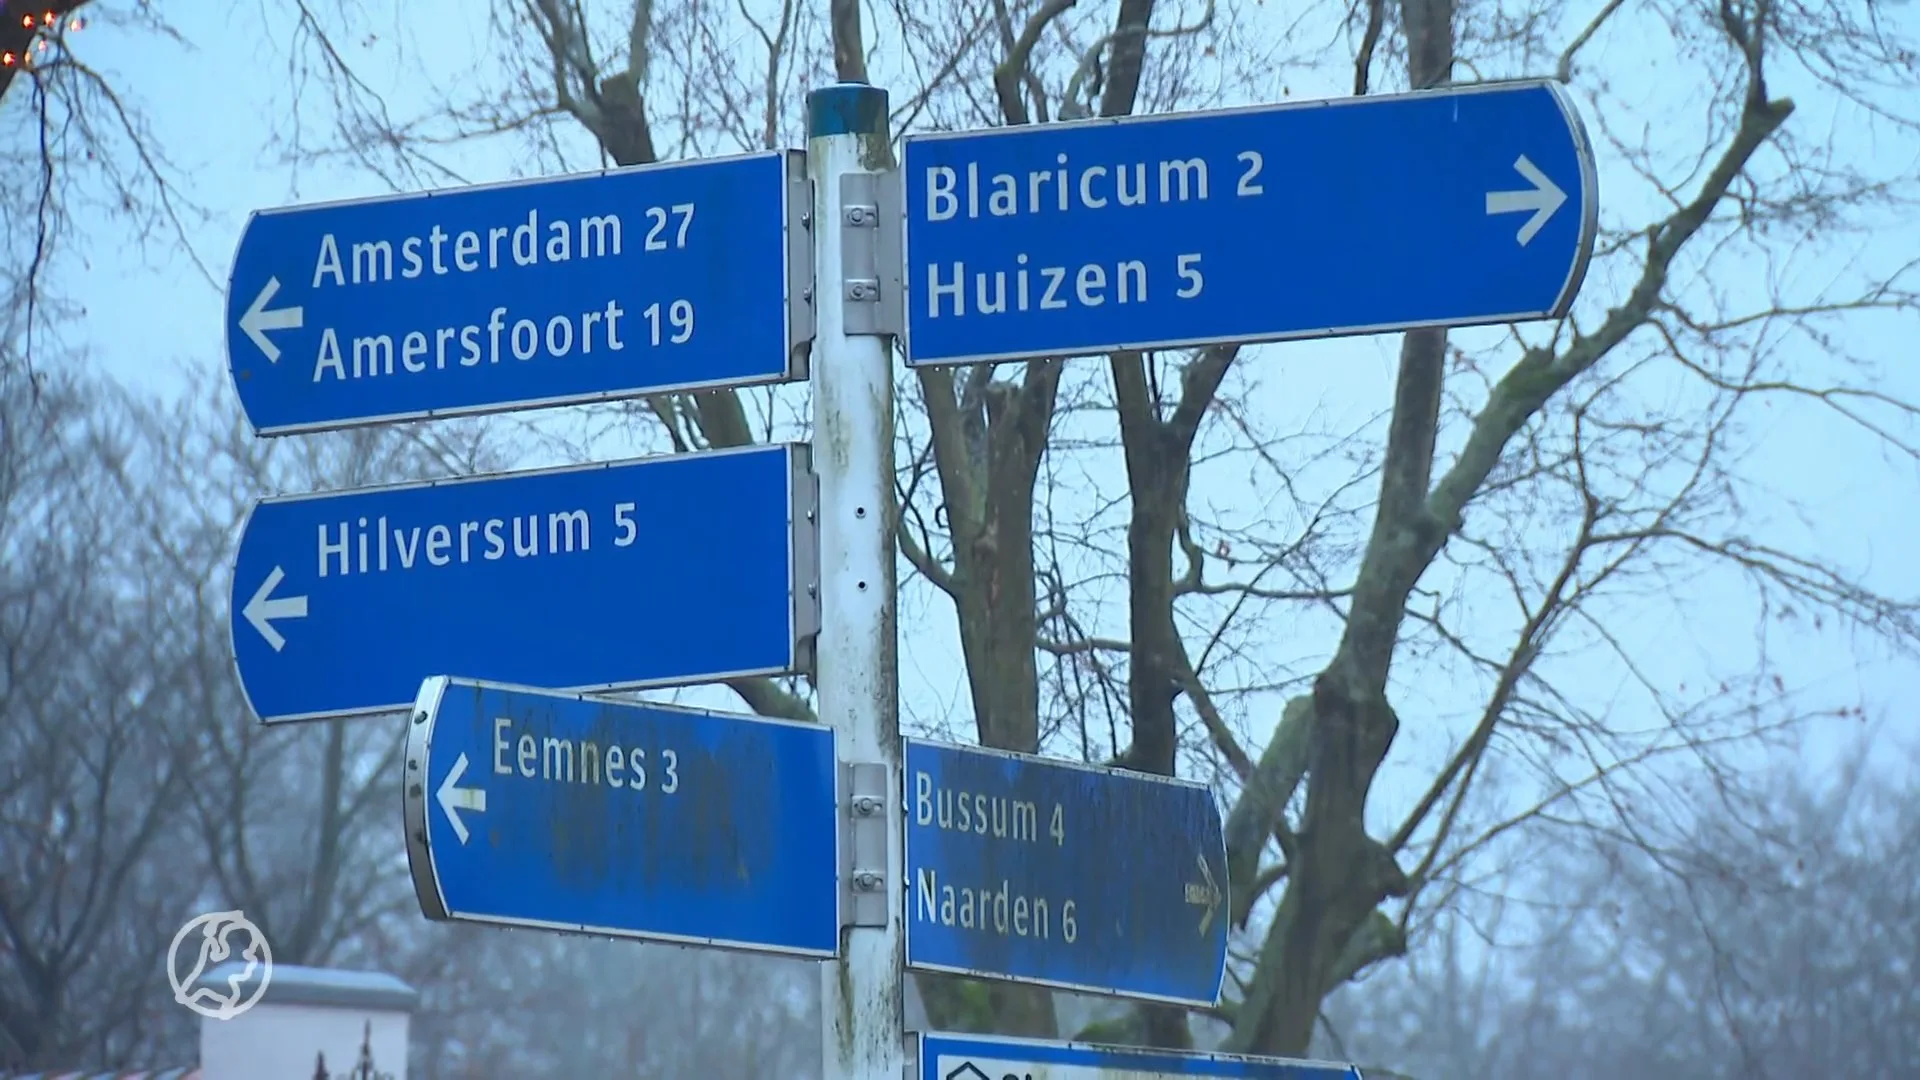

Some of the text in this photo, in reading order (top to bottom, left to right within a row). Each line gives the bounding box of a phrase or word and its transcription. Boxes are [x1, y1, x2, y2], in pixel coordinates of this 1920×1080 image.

[926, 150, 1264, 222] Blaricum 2
[312, 202, 695, 288] Amsterdam 27
[927, 253, 1204, 318] Huizen 5
[313, 299, 694, 383] Amersfoort 19
[318, 502, 637, 578] Hilversum 5
[494, 717, 679, 794] Eemnes 3
[916, 771, 1065, 846] Bussum 4
[917, 867, 1077, 944] Naarden 6
